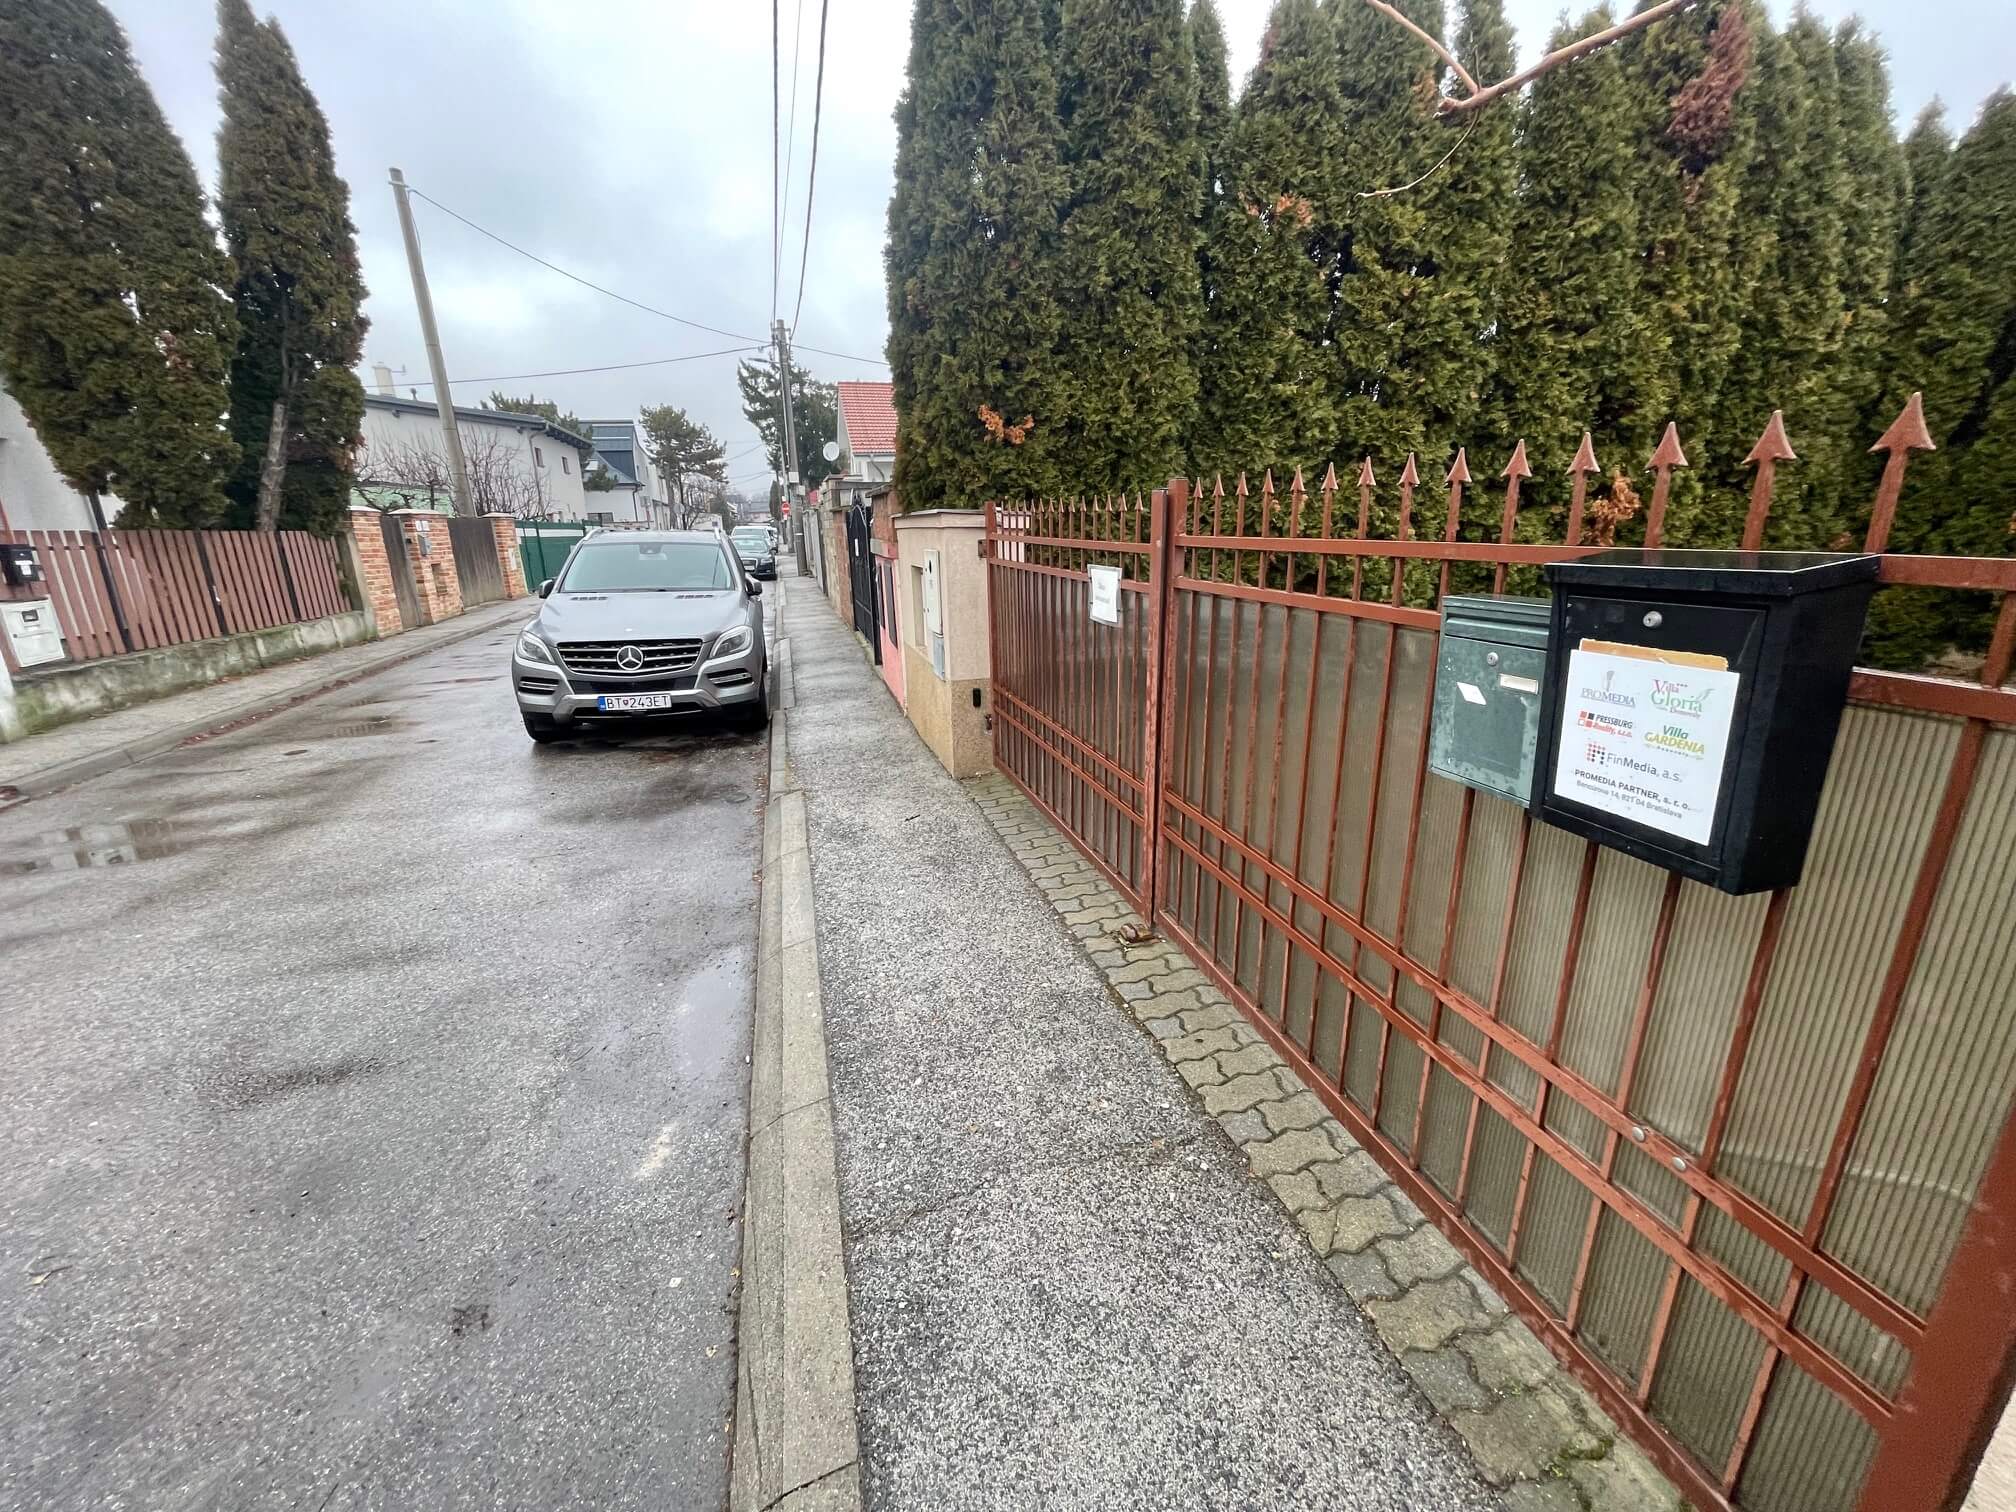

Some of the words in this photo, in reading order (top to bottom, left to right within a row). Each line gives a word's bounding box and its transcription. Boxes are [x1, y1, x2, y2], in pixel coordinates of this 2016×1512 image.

[1652, 678, 1679, 695] Villa
[1581, 687, 1636, 708] PROMEDIA
[1651, 690, 1702, 712] Gloria
[1595, 714, 1633, 729] PRESSBURG
[1663, 725, 1689, 739] Villa
[1643, 732, 1705, 754] GARDENIA
[1606, 753, 1660, 777] FinMedia,
[1662, 768, 1683, 783] a.s.
[1574, 768, 1616, 788] PROMEDIA
[1618, 782, 1661, 803] PARTNER,
[1646, 801, 1683, 819] Bratislava
